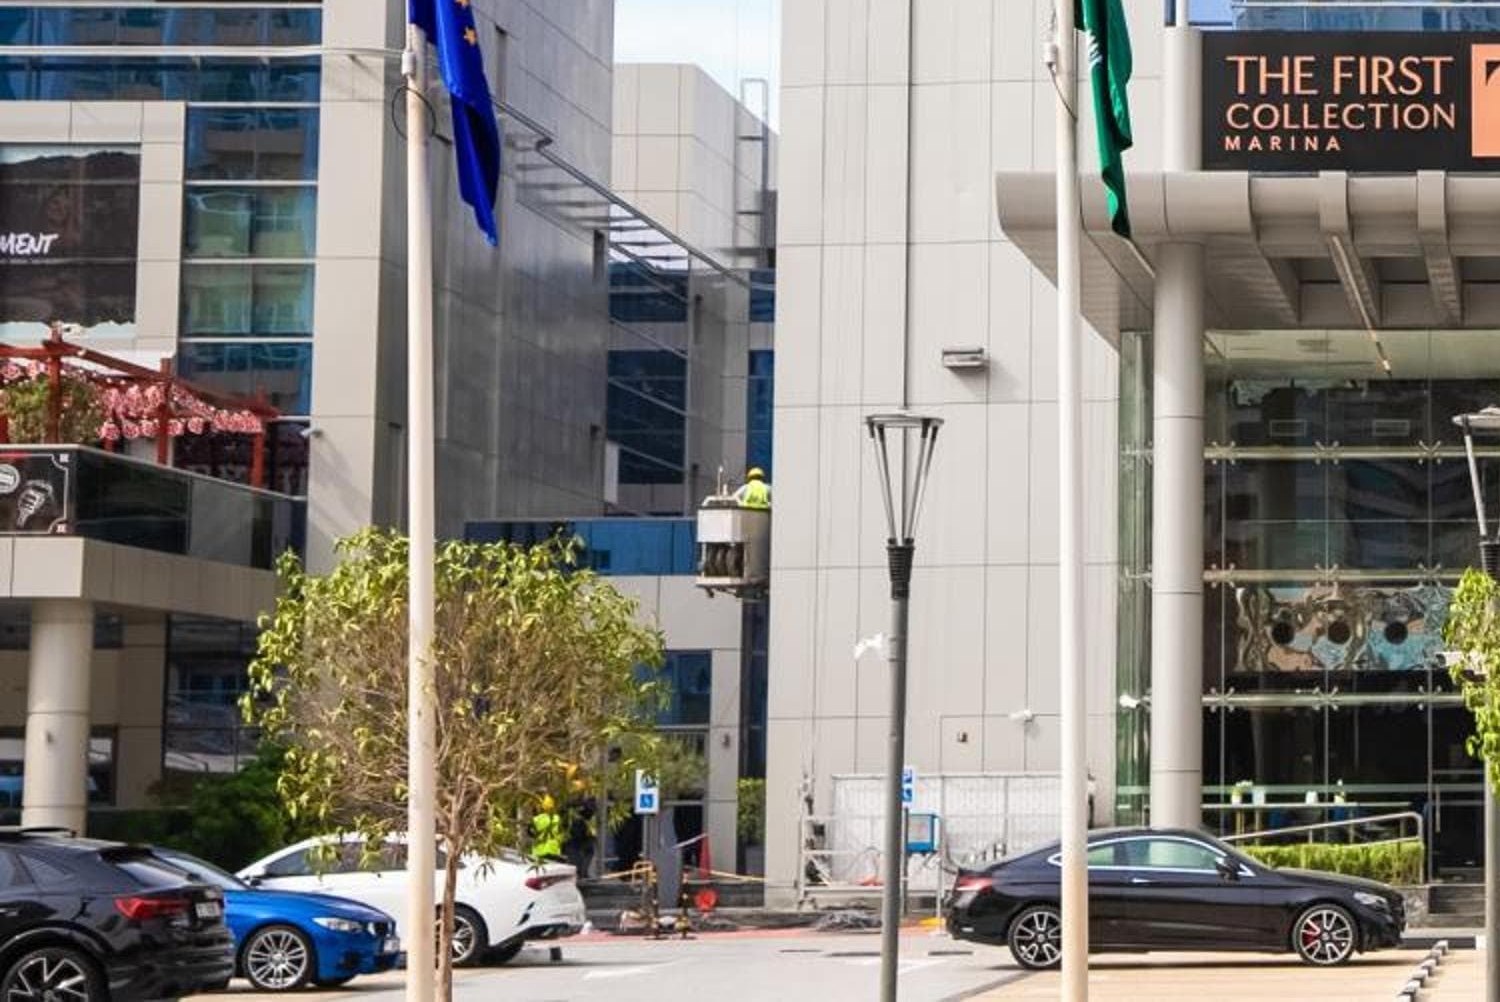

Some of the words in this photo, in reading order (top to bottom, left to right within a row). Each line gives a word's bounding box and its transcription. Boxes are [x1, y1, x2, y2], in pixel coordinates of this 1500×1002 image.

[1225, 55, 1319, 95] THE
[1332, 55, 1454, 95] FIRST
[1226, 102, 1456, 130] COLLECTION
[1224, 135, 1341, 152] MARINA
